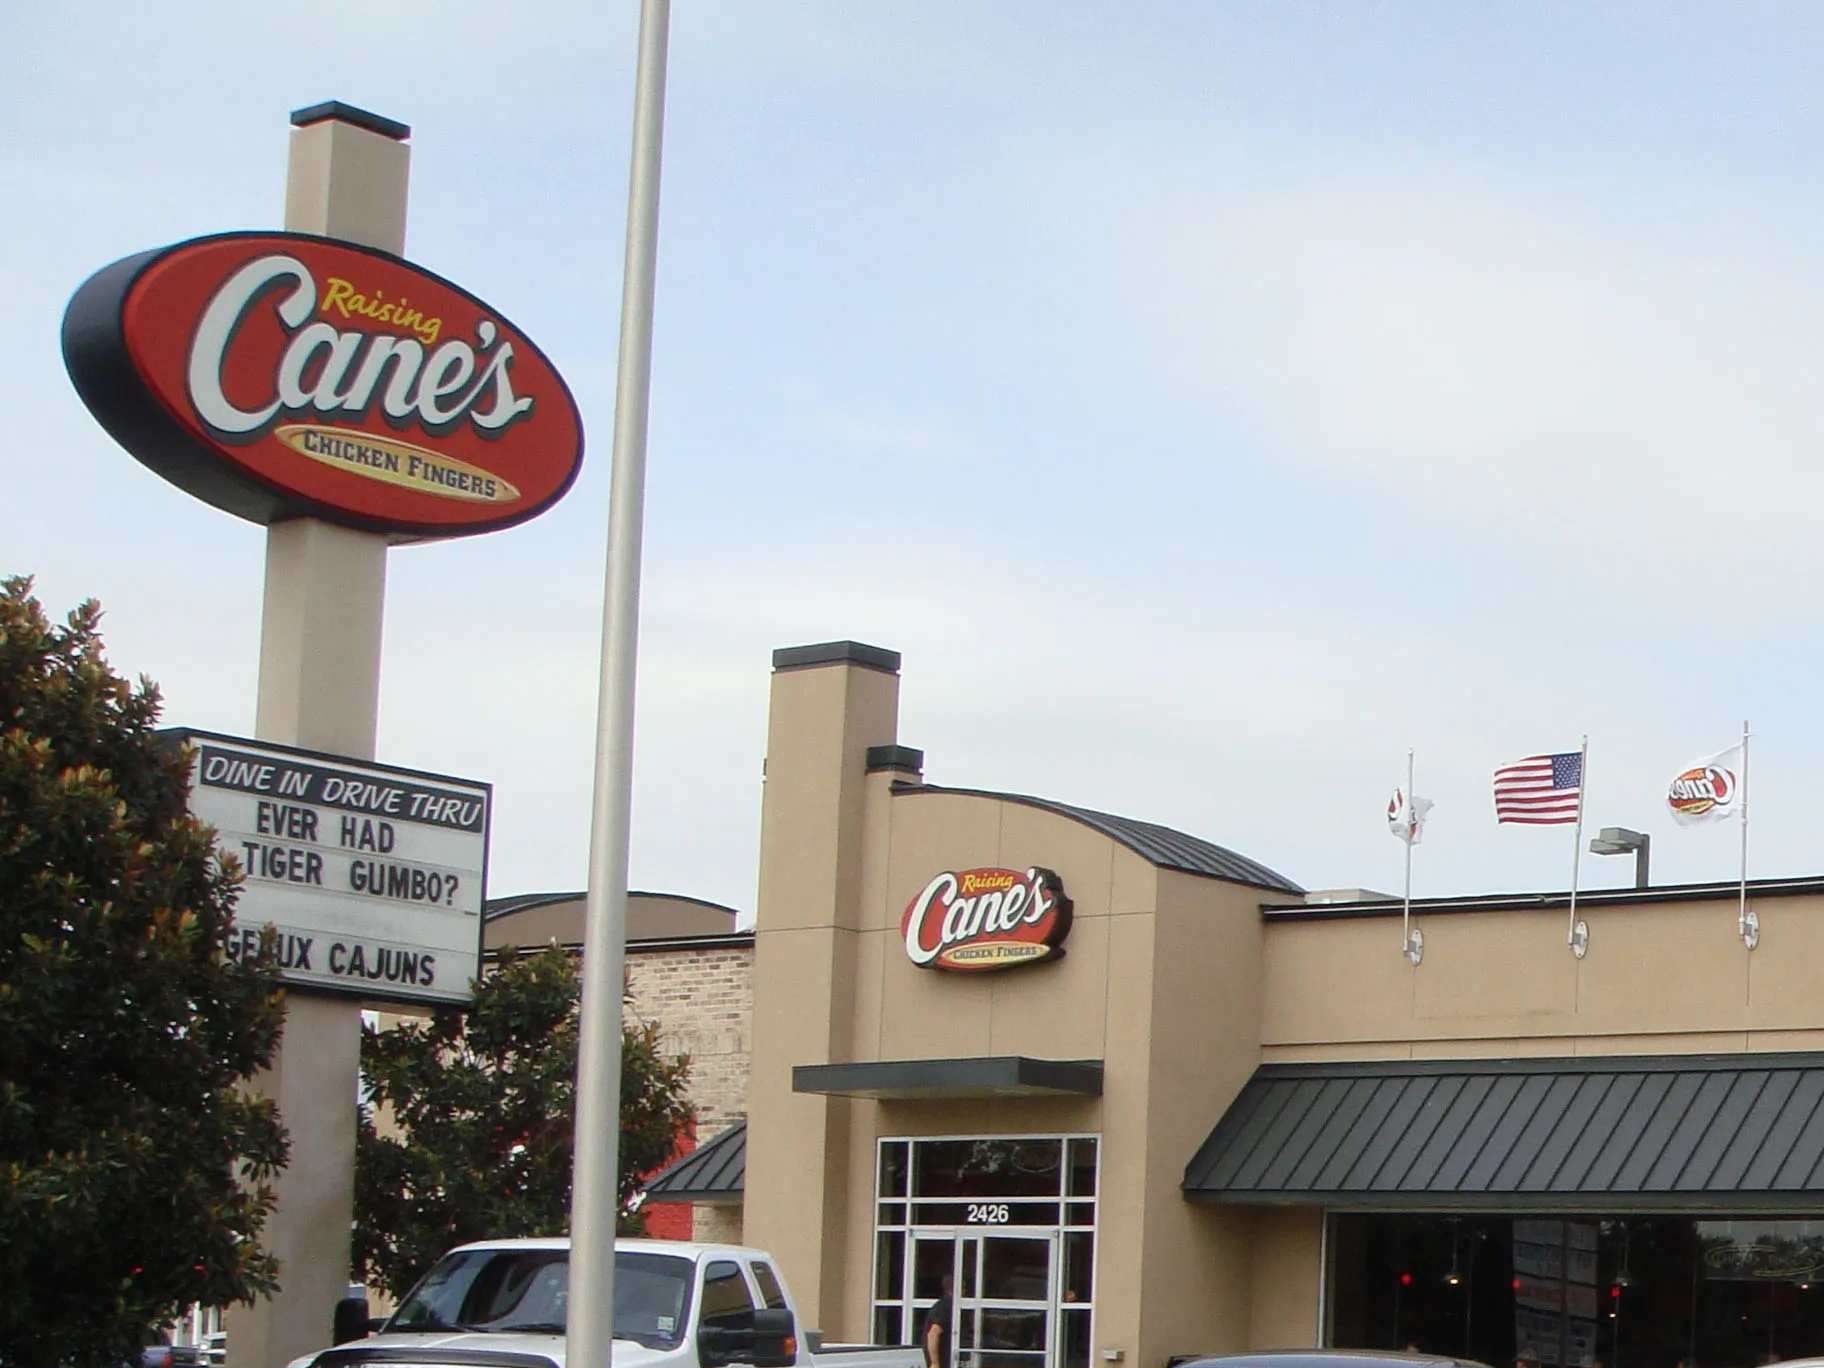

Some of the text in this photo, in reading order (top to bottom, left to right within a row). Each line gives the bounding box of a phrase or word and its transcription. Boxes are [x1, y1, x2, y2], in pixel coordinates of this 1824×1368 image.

[187, 254, 535, 434] Cane's
[321, 276, 443, 345] Raising
[302, 429, 497, 498] CHICKEN FINGERS
[204, 756, 482, 827] DINE IN DRIVE THRU
[256, 801, 396, 854] EVER HAD
[242, 841, 460, 907] TIGER GUMBO?
[961, 872, 1015, 893] Raising
[905, 867, 1053, 964] Cane's
[226, 928, 437, 987] GEUX CAJUNS
[967, 1203, 1010, 1223] 2426
